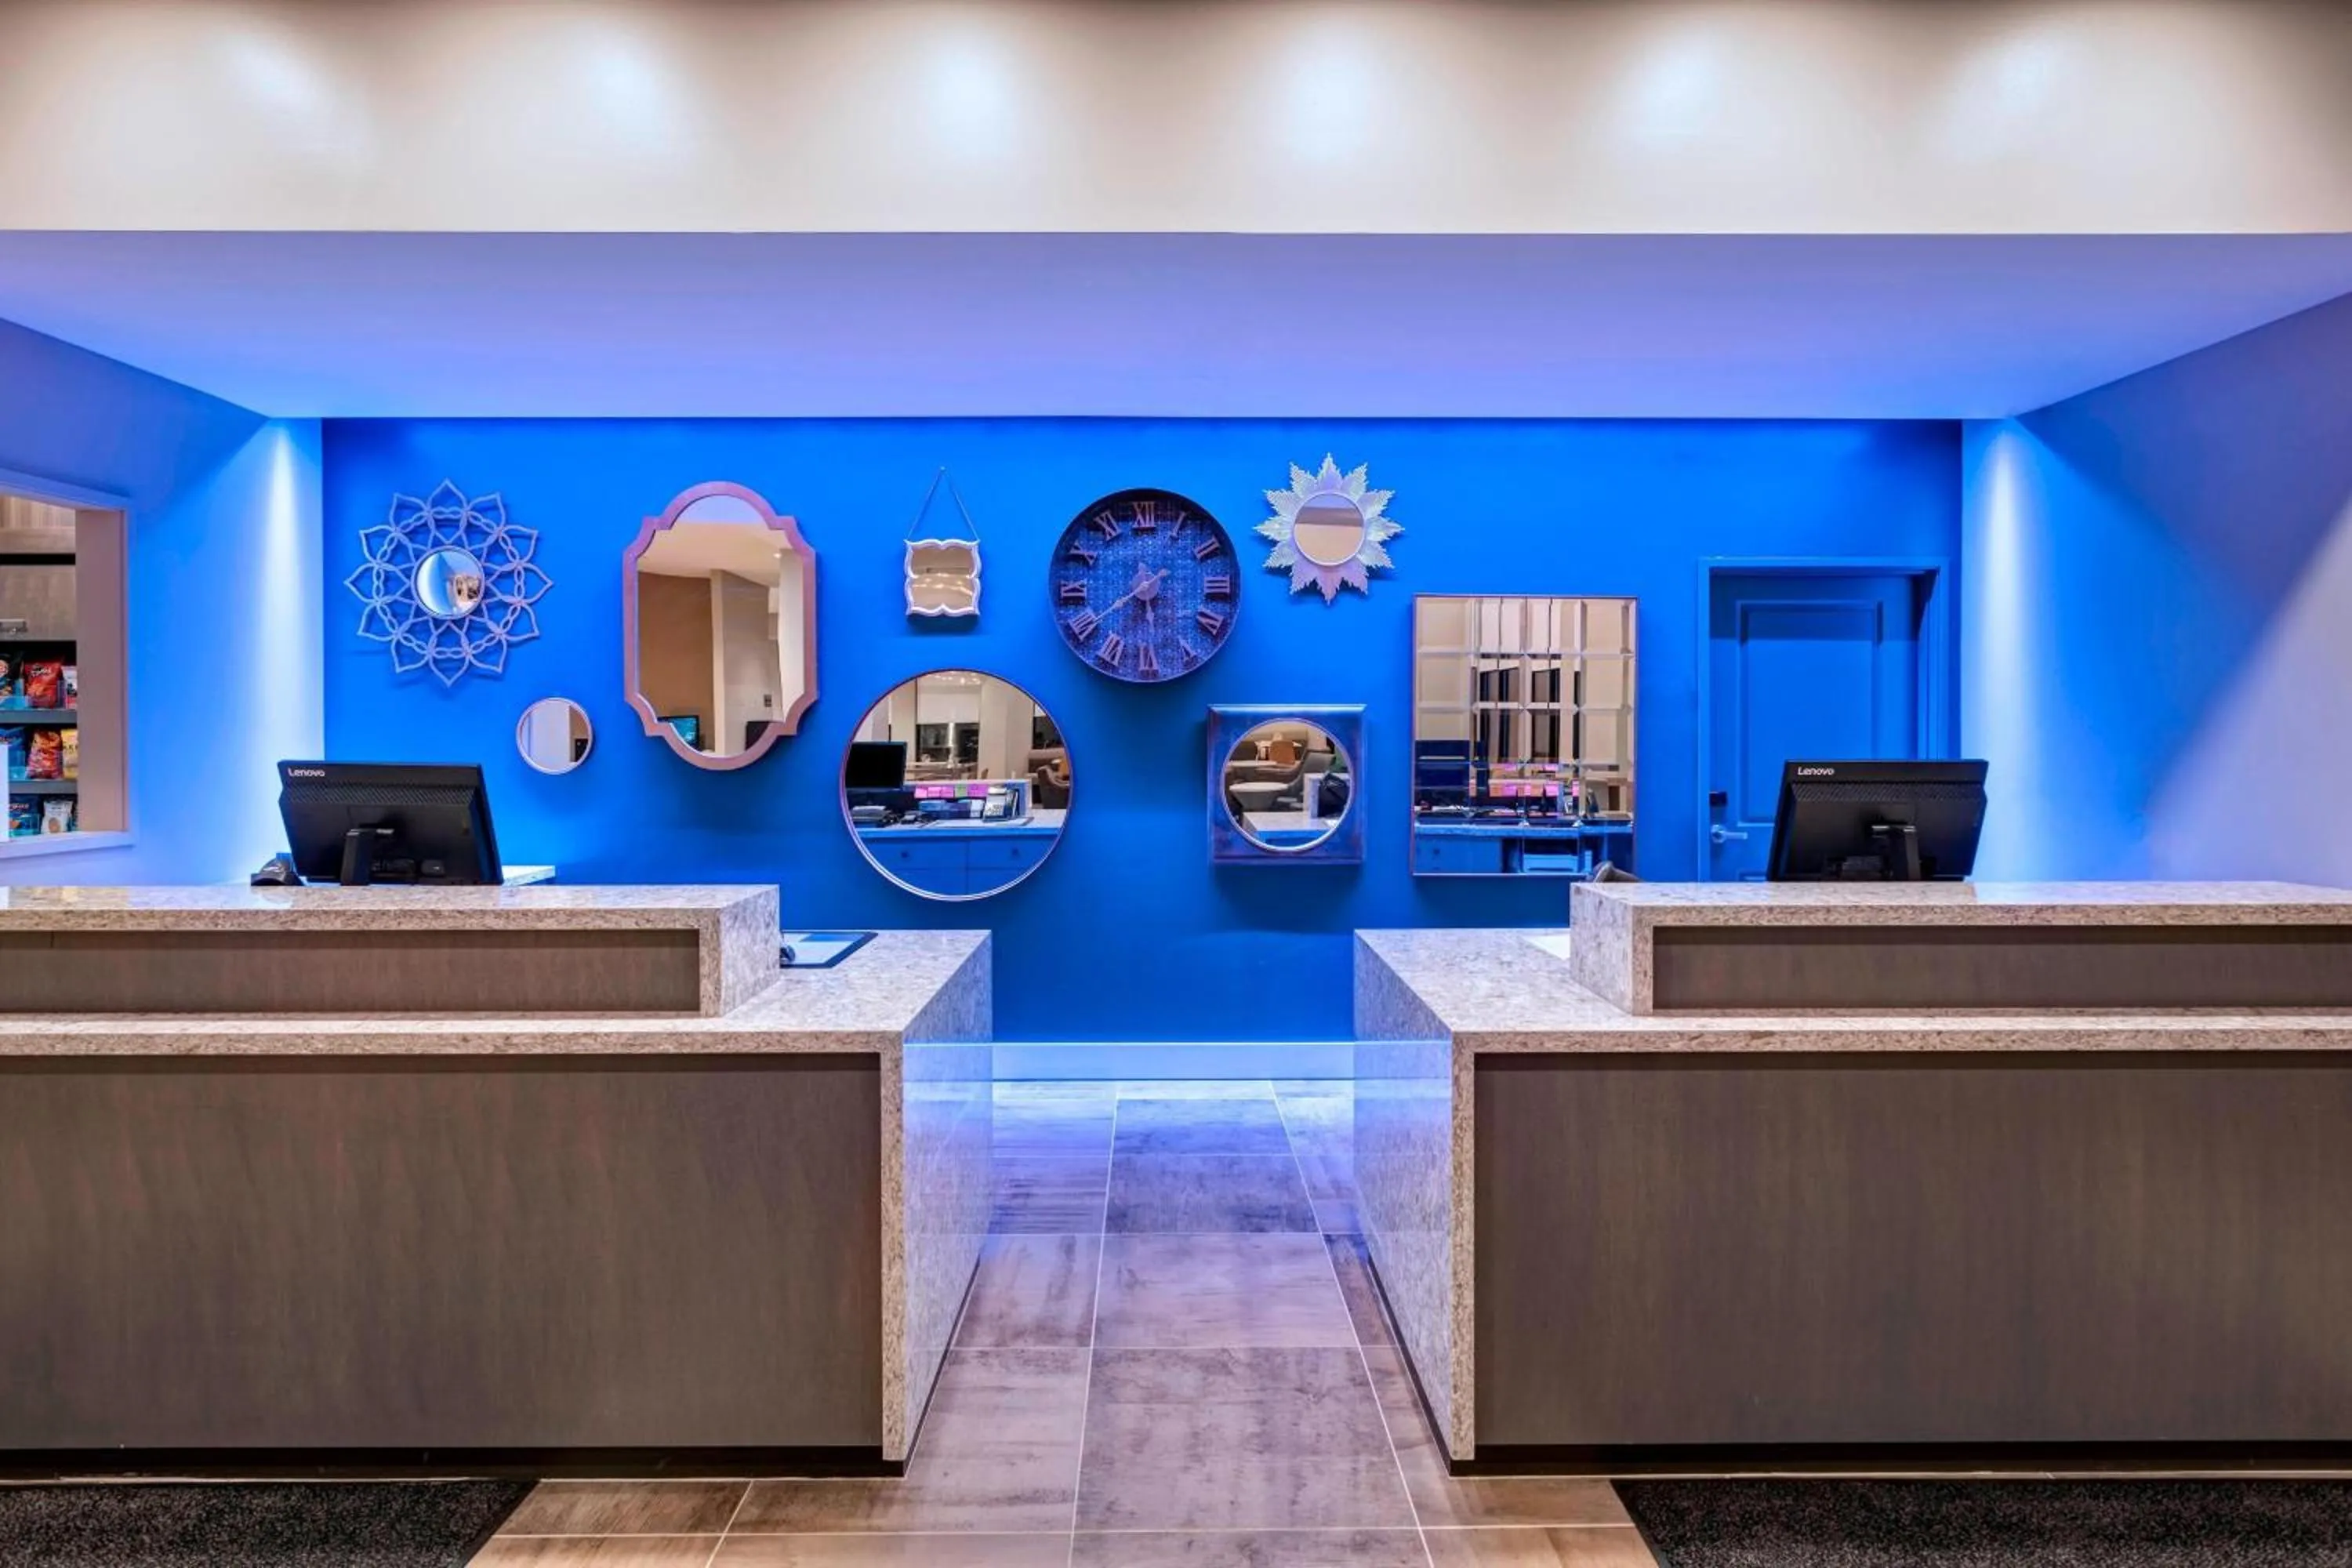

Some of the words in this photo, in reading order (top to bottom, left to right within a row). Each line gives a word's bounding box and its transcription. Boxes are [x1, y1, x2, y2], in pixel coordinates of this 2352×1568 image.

[1094, 510, 1121, 541] XI
[1133, 501, 1156, 528] XII
[1170, 511, 1187, 538] I
[1069, 541, 1098, 565] X
[1192, 537, 1220, 560] II
[1061, 579, 1087, 597] IX
[1203, 576, 1230, 594] III
[1068, 608, 1098, 641] VIII
[1196, 606, 1225, 637] IV
[1097, 632, 1124, 666] VII
[1138, 644, 1160, 670] VI
[1178, 636, 1197, 662] V
[287, 768, 326, 777] Lenovo
[1797, 766, 1835, 776] Lenovo
